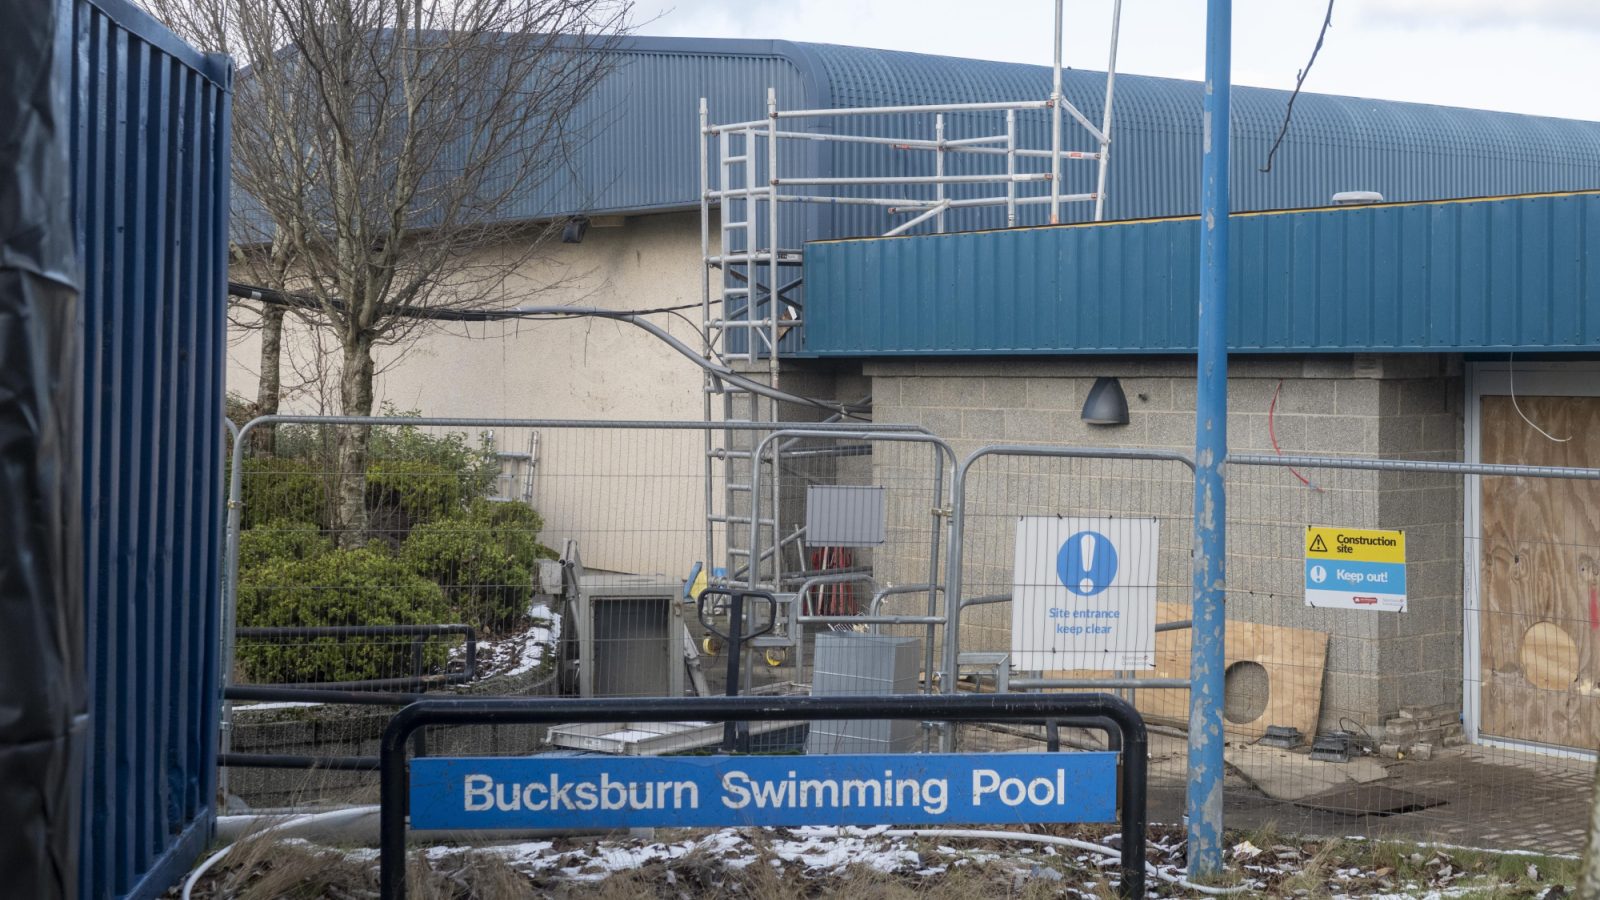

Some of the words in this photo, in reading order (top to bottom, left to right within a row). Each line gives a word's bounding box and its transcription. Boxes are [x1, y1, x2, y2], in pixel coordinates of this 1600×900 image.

[1336, 534, 1397, 547] Construction
[1336, 544, 1353, 554] site
[1336, 569, 1364, 583] Keep
[1366, 571, 1389, 583] out!
[1049, 608, 1070, 618] Site
[1072, 609, 1120, 619] entrance
[1056, 624, 1083, 636] keep
[1085, 624, 1112, 634] clear
[464, 773, 699, 812] Bucksburn
[721, 769, 948, 815] Swimming
[972, 768, 1065, 806] Pool
